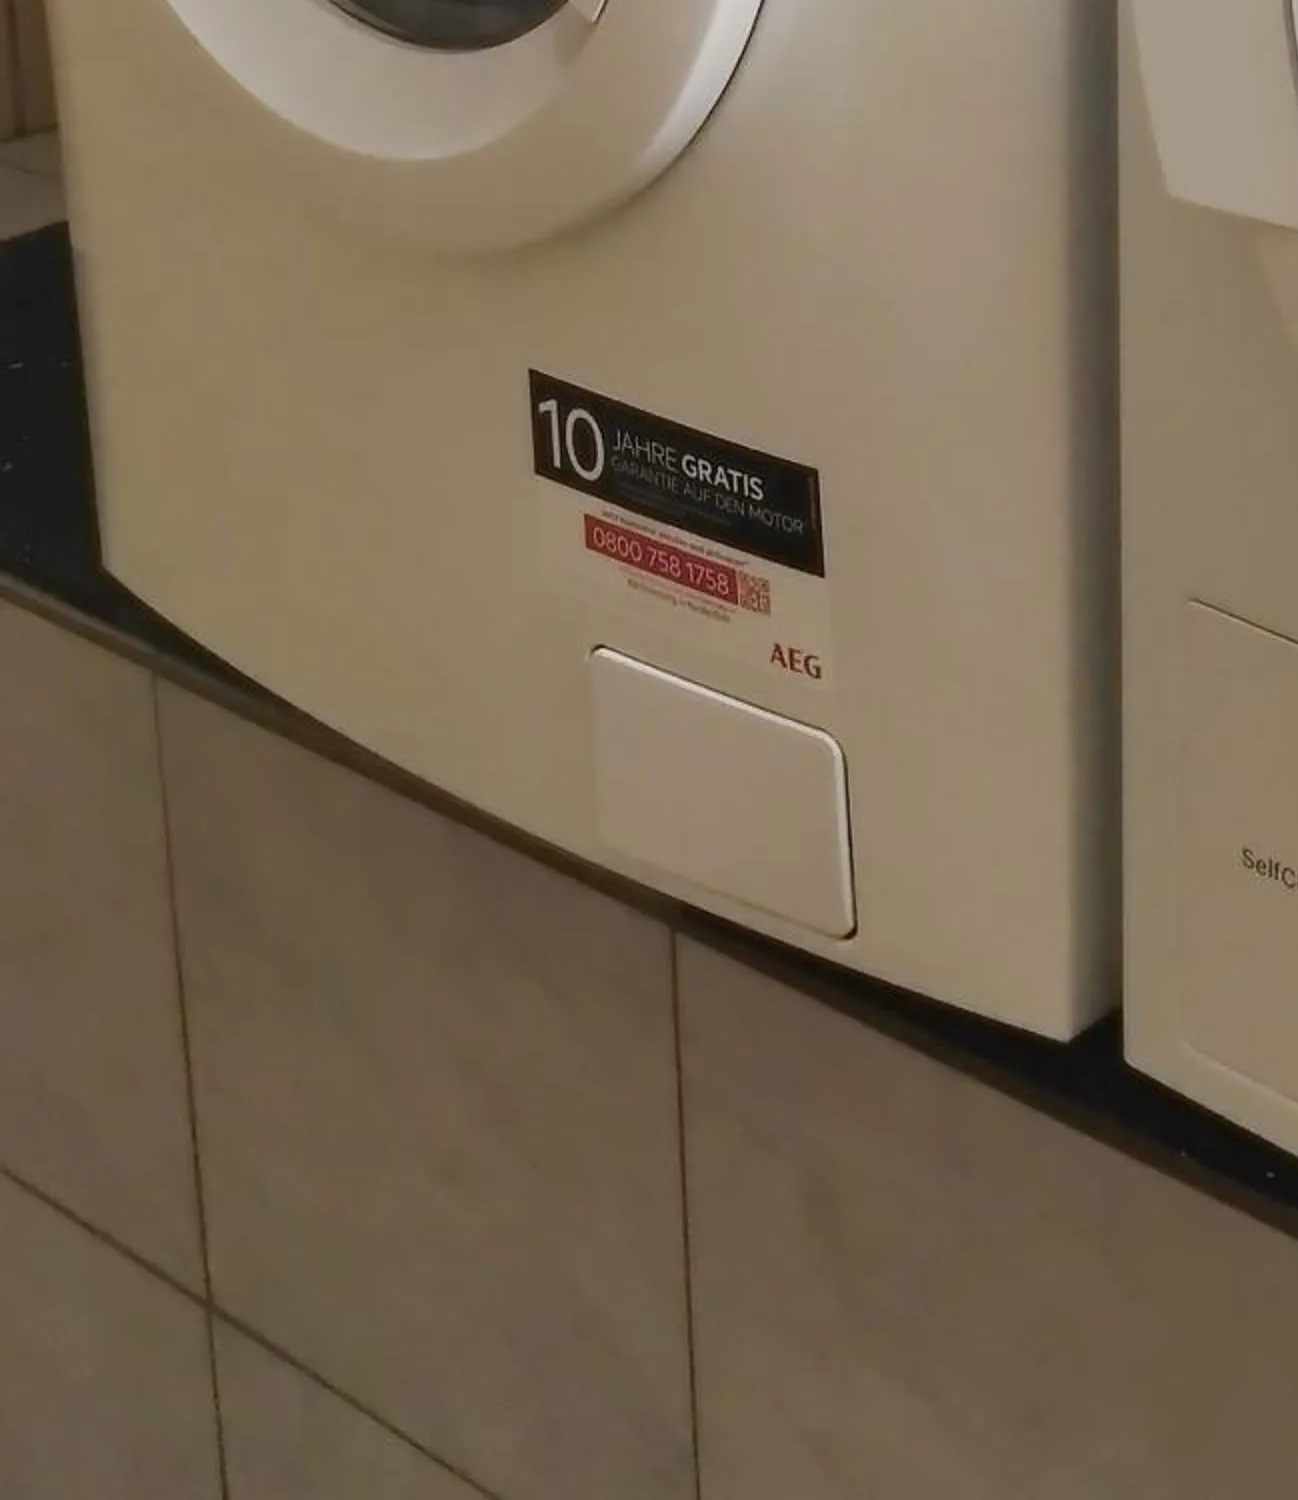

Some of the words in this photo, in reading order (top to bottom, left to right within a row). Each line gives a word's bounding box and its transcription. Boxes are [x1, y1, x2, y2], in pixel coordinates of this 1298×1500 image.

[537, 398, 605, 482] 10
[611, 429, 678, 470] JAHRE
[680, 454, 765, 501] GRATIS
[611, 456, 680, 494] GARANTIE
[683, 480, 713, 504] AUF
[714, 491, 746, 517] DEN
[747, 502, 805, 535] MOTOR
[593, 526, 642, 563] 0800
[645, 546, 682, 578] 758
[684, 562, 729, 596] 1758
[770, 643, 822, 679] AEG
